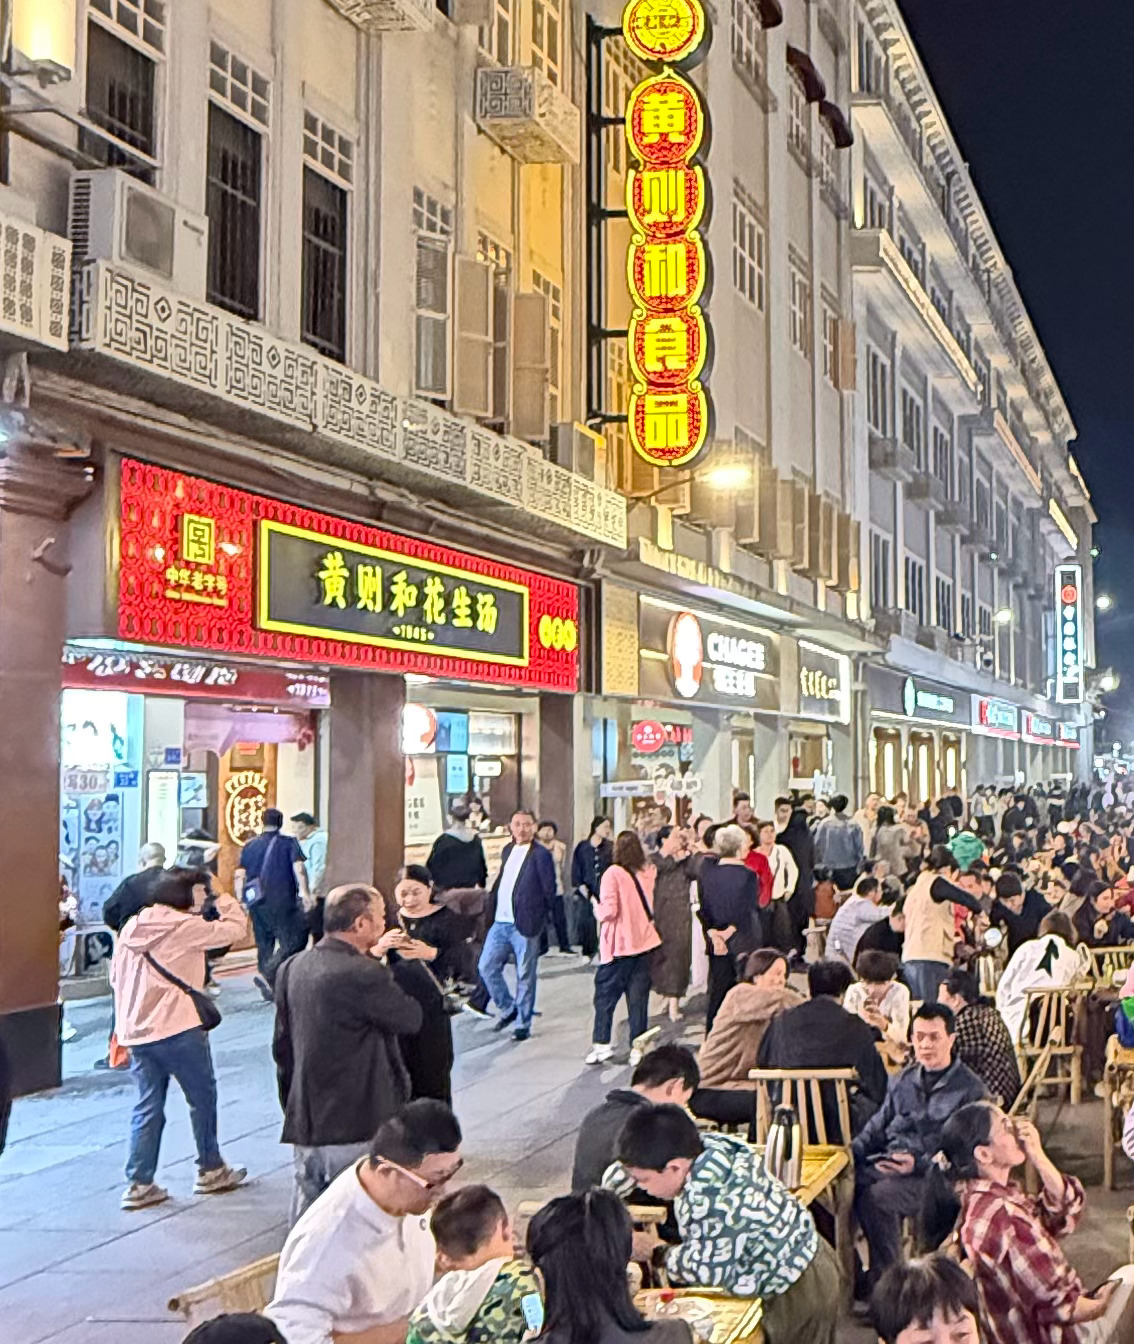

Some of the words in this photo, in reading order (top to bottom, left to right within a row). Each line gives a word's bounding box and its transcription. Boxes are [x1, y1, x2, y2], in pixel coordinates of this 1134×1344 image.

[317, 551, 498, 635] 黄则和花生汤
